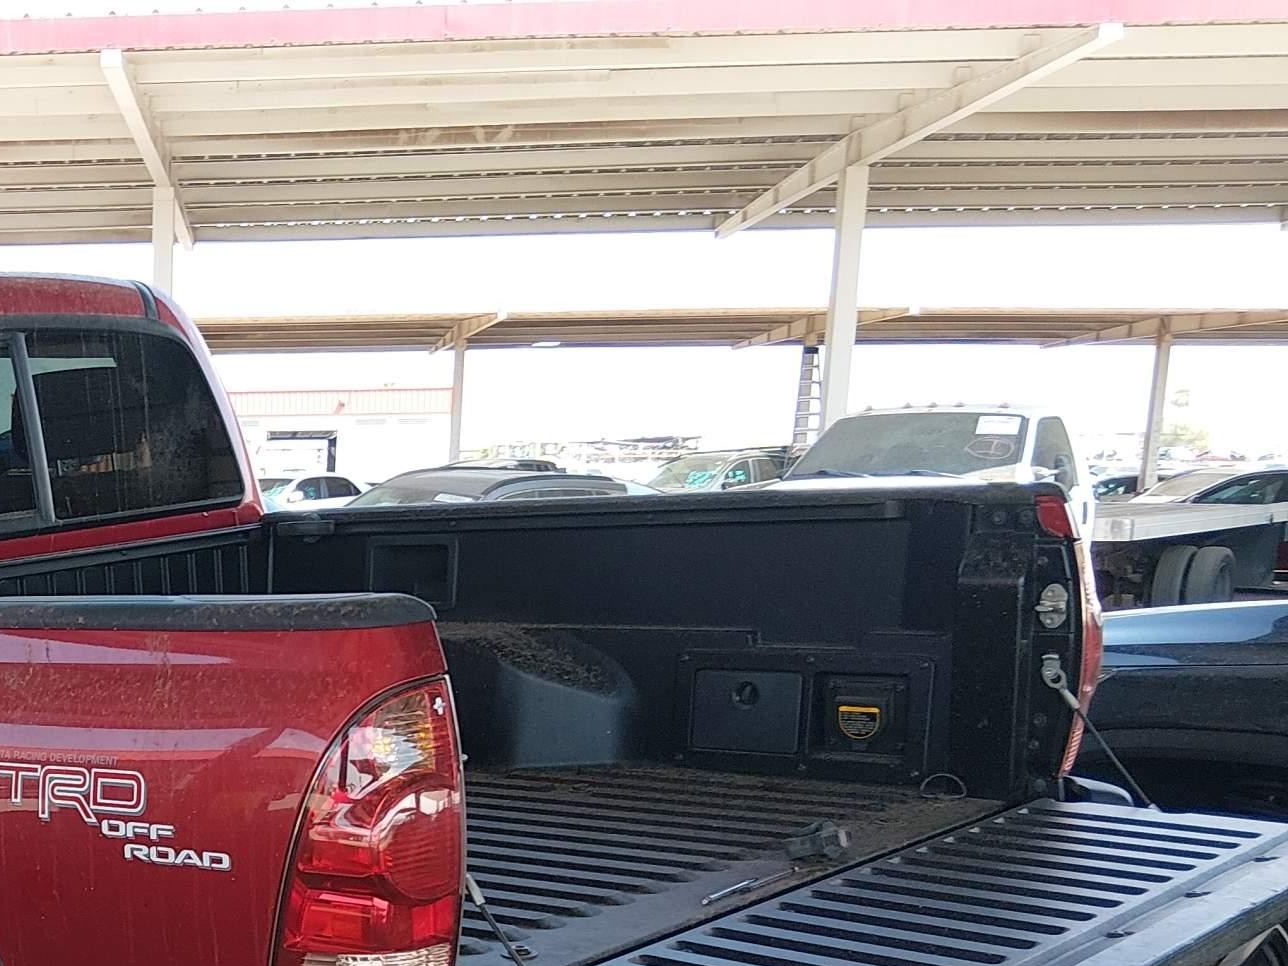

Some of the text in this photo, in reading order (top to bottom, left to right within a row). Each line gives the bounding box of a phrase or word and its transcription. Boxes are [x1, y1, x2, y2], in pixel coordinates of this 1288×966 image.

[13, 750, 47, 762] RACING
[49, 752, 119, 766] DEVELOPMENT
[100, 819, 175, 840] OFF
[123, 842, 232, 871] ROAD
